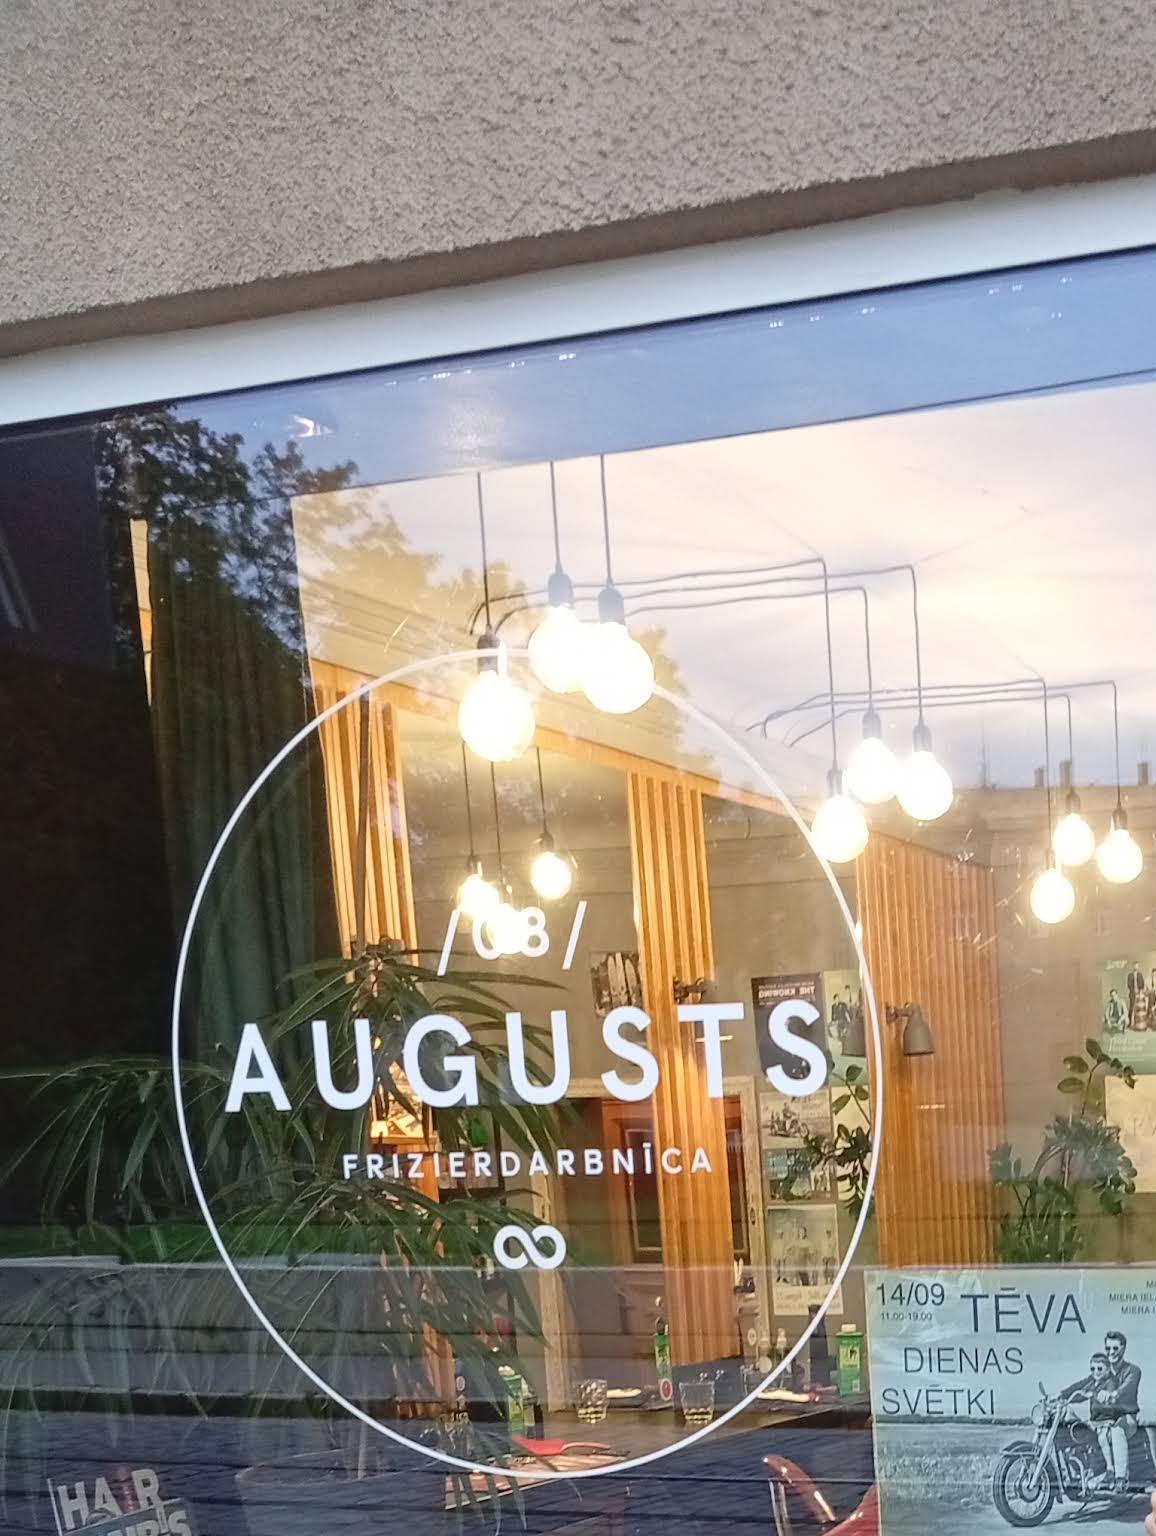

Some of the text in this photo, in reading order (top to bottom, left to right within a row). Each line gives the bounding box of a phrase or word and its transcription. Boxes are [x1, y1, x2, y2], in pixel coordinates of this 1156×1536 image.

[224, 999, 828, 1112] AUGUSTS
[342, 1145, 712, 1180] FRIZIERDARBNĪCA
[876, 1282, 945, 1306] 14/09
[960, 1287, 1086, 1334] TĒVA
[904, 1347, 1024, 1375] DIENAS
[882, 1384, 995, 1416] SVĒTKI
